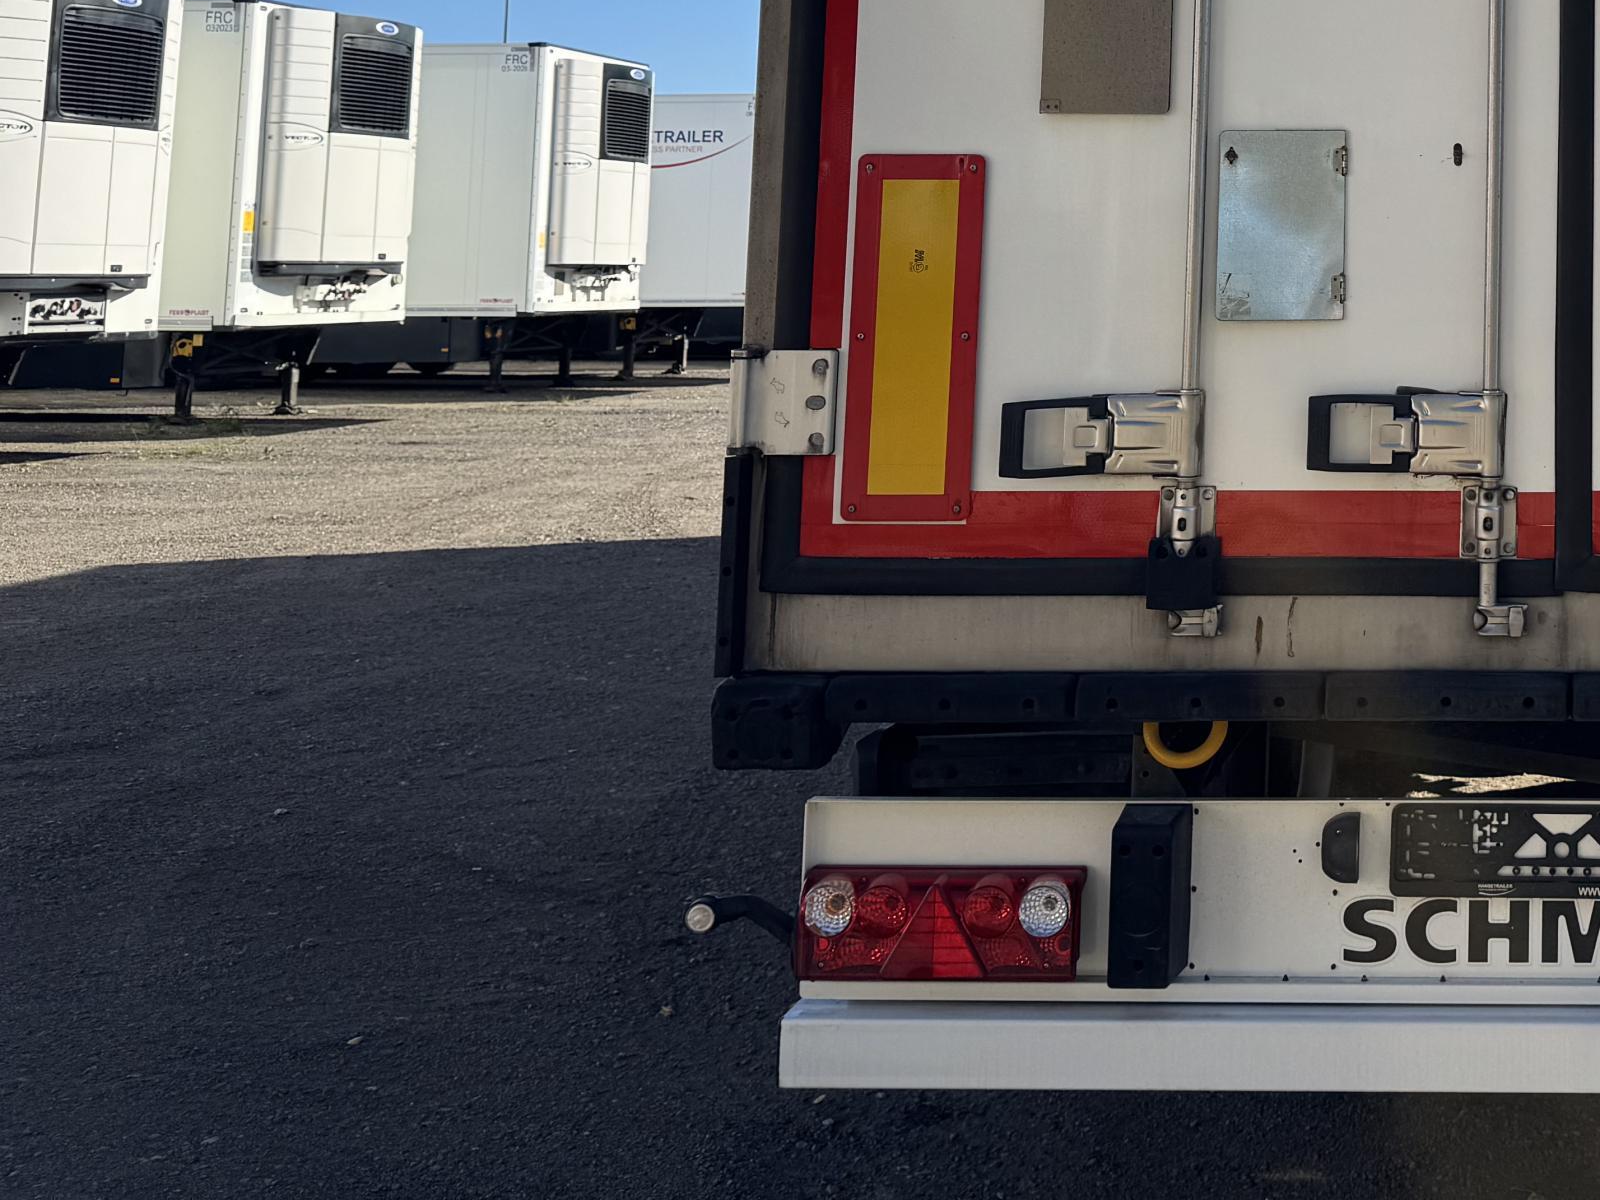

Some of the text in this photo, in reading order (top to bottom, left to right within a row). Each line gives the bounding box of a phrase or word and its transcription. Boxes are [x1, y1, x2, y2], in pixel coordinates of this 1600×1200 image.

[205, 10, 233, 24] FRC
[505, 54, 529, 65] FRC
[651, 130, 724, 143] TRAILER
[665, 145, 703, 153] PARTNER
